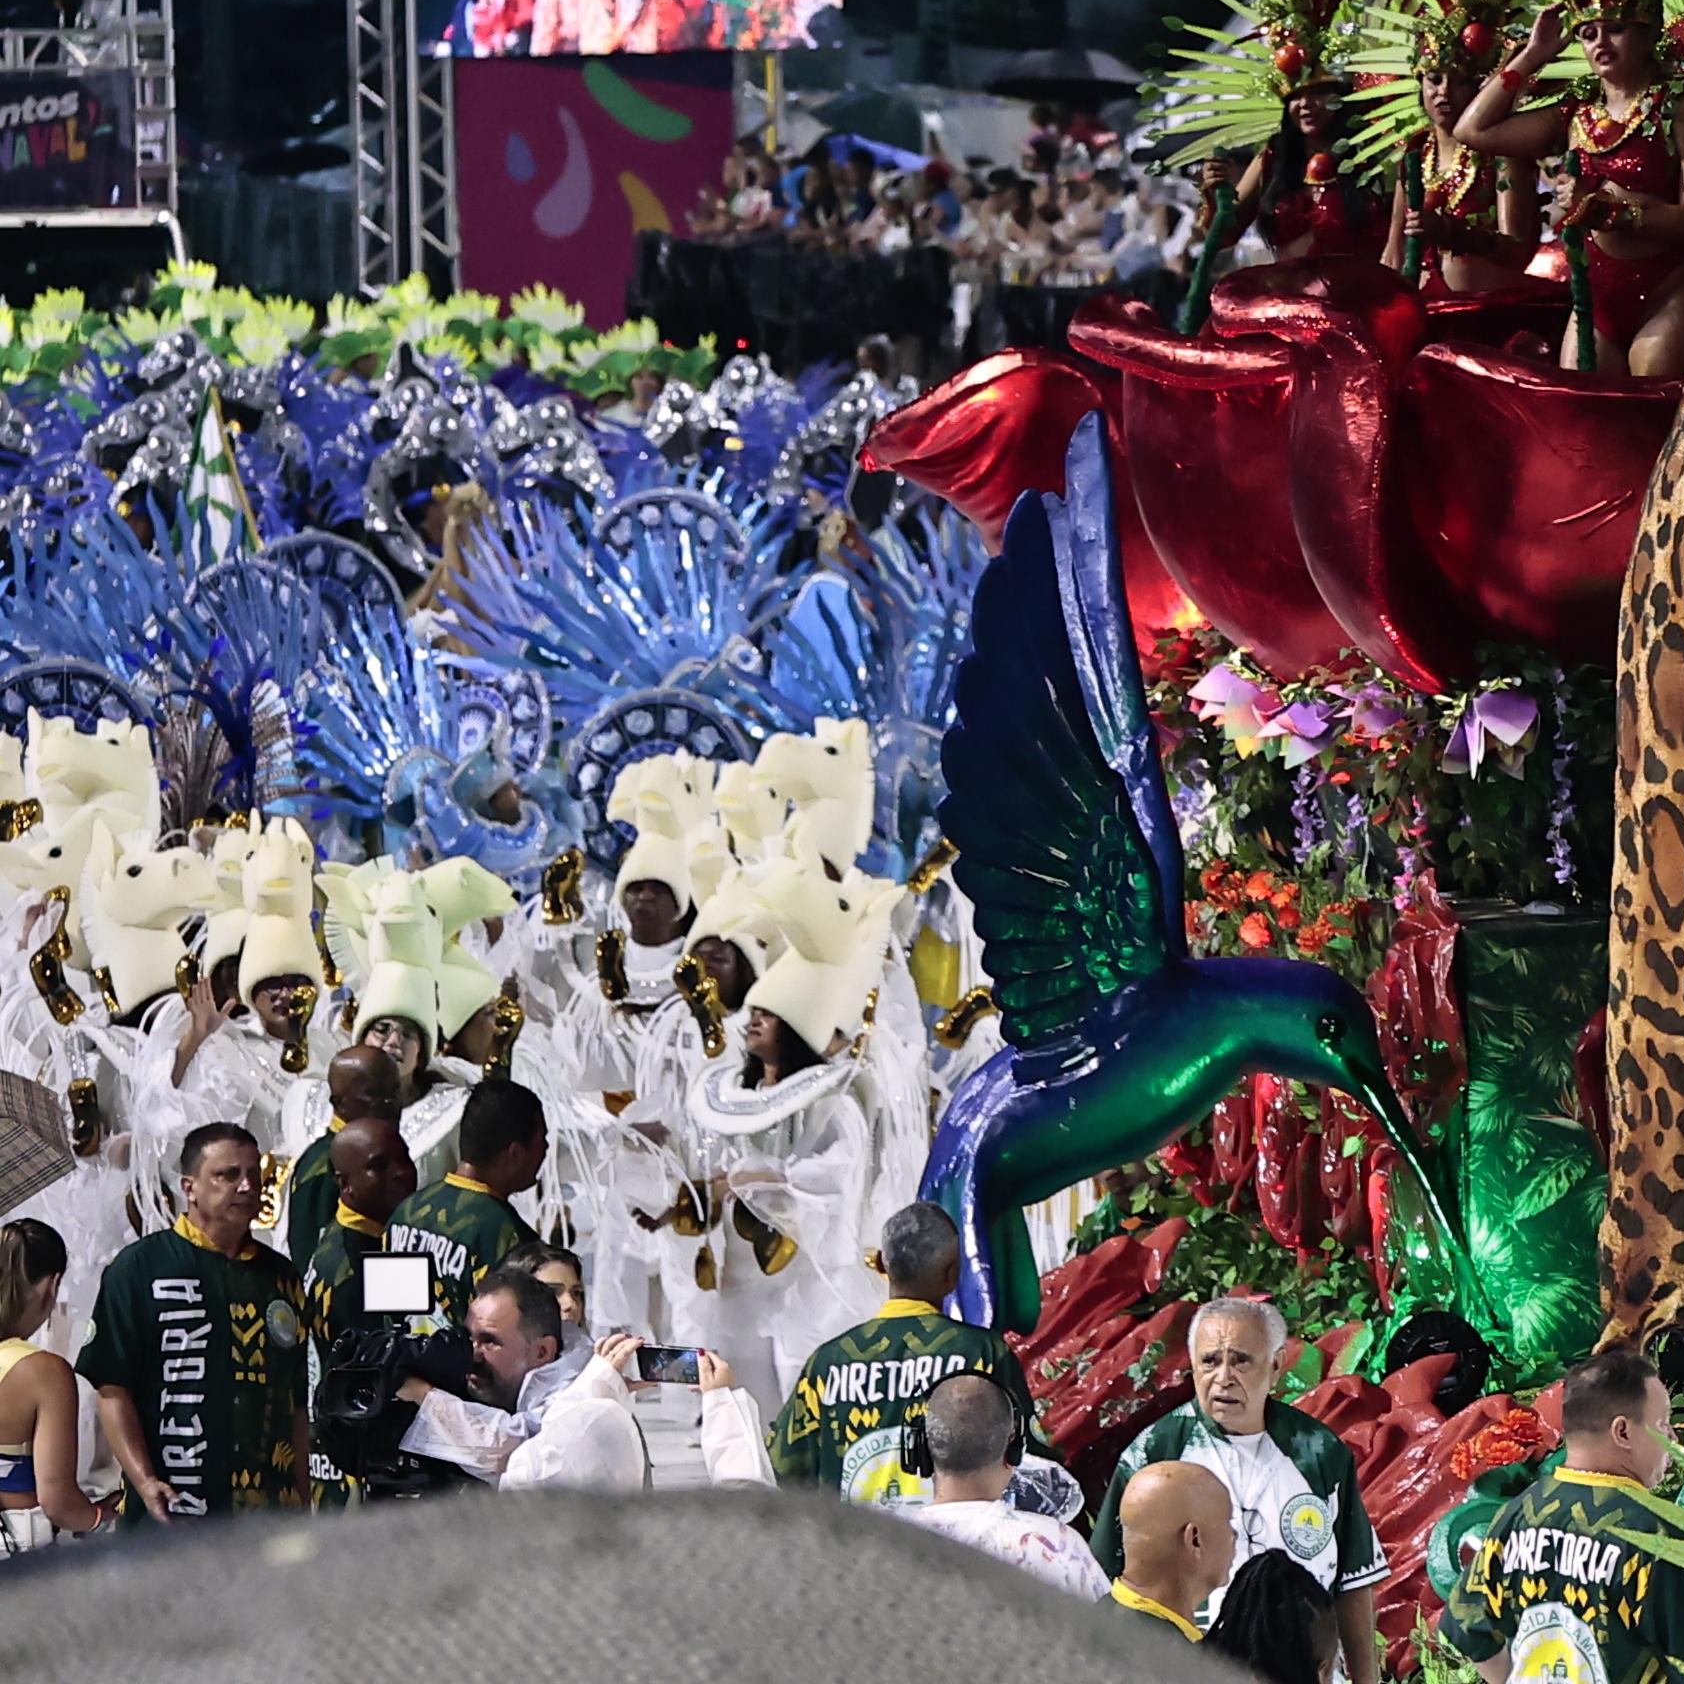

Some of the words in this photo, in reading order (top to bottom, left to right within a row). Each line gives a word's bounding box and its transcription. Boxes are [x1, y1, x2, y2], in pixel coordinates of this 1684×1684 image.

[152, 1278, 213, 1516] DIRETORIA
[842, 1434, 900, 1484] MOCIDA
[1503, 1527, 1622, 1587] DIRETORIA
